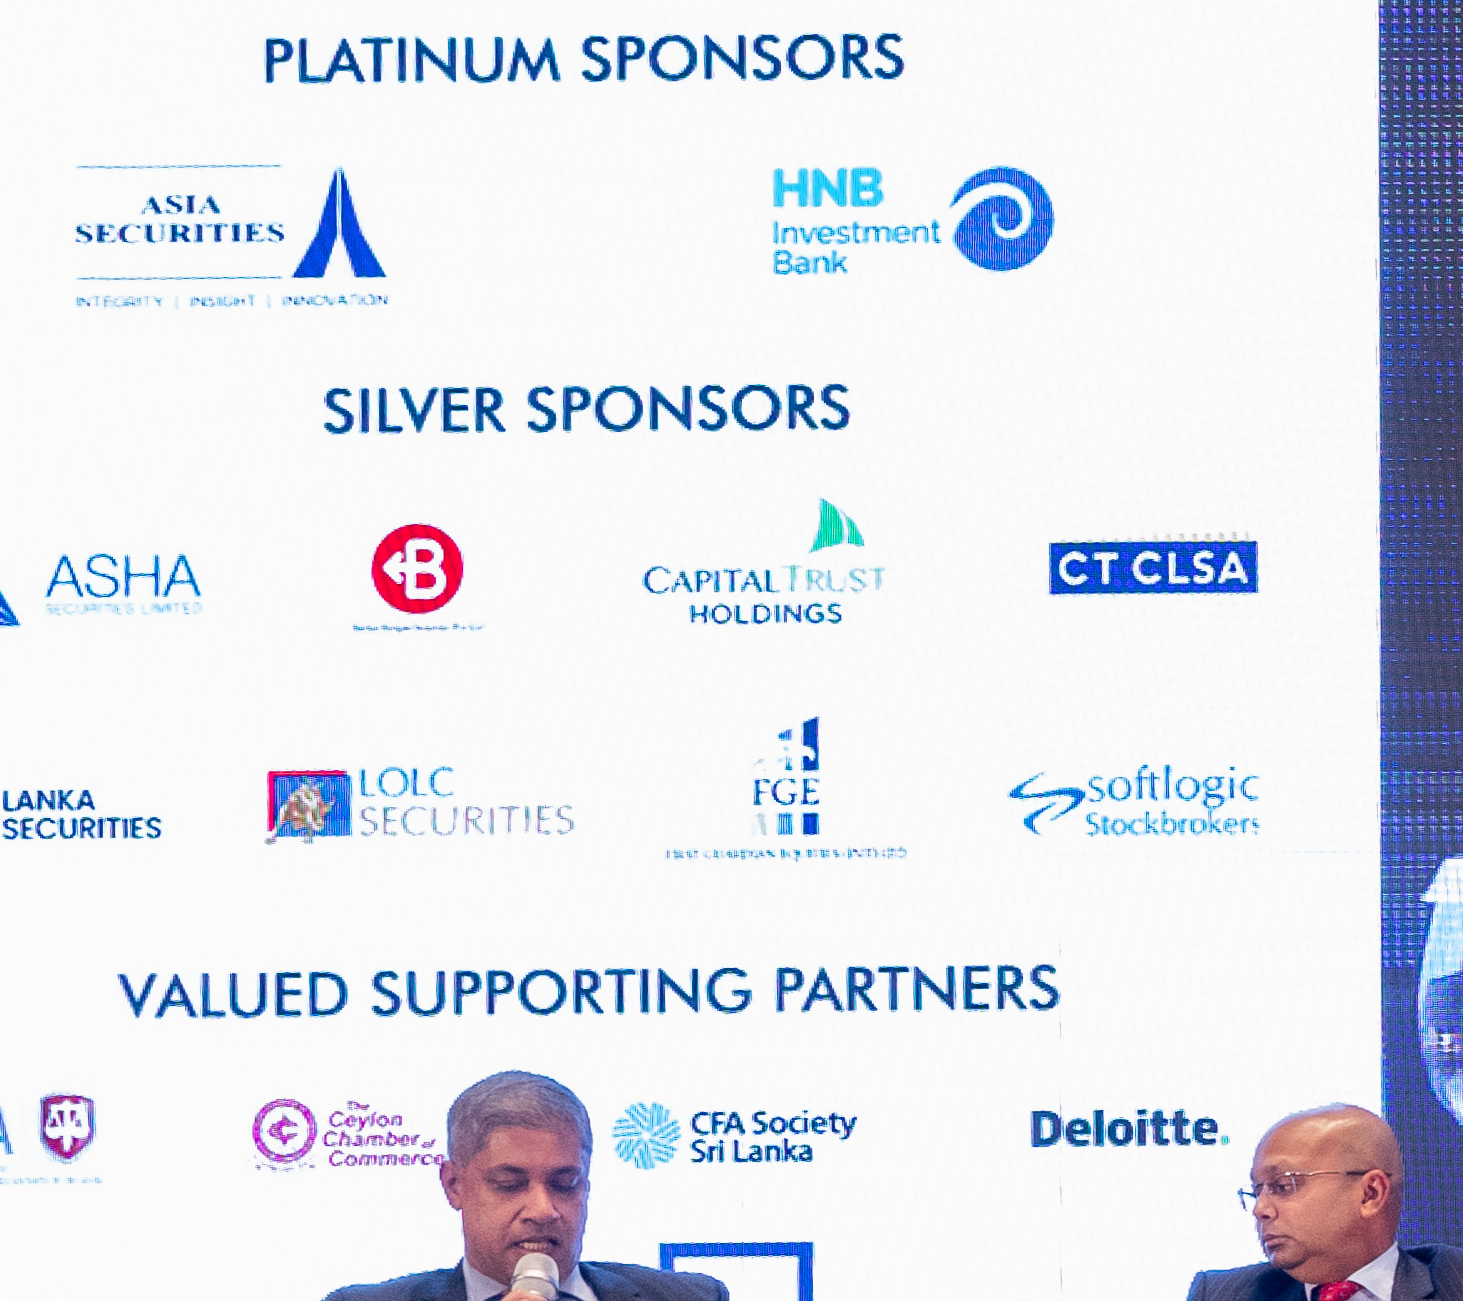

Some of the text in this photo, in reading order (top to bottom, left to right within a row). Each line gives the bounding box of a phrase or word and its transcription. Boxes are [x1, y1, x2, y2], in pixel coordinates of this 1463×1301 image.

[264, 33, 904, 84] PLATINUM SPONSORS
[773, 167, 884, 208] HNB
[141, 195, 221, 215] ASIA
[75, 223, 284, 244] SECURITIES
[773, 219, 941, 246] Investment
[773, 249, 848, 275] Bank
[324, 383, 850, 435] SILVER SPONSORS
[45, 553, 201, 598] ASHA
[642, 564, 886, 594] CAPITAL TRUST
[1058, 549, 1249, 585] CT CLSA
[689, 602, 842, 625] HOLDINGS
[359, 766, 454, 797] LOLC
[753, 778, 822, 806] FGE
[1087, 765, 1260, 809] softlogic
[3, 789, 95, 812] LANKA
[2, 816, 162, 840] SECURITIES
[361, 805, 574, 836] SECURITIES
[1086, 812, 1260, 837] Stockbrokers
[118, 964, 1061, 1018] VALUED SUPPORTING PARTNERS
[328, 1111, 403, 1132] Ceylon
[690, 1110, 857, 1140] CFA Society
[323, 1130, 420, 1147] Chamber
[690, 1138, 813, 1163] Sri Lanka
